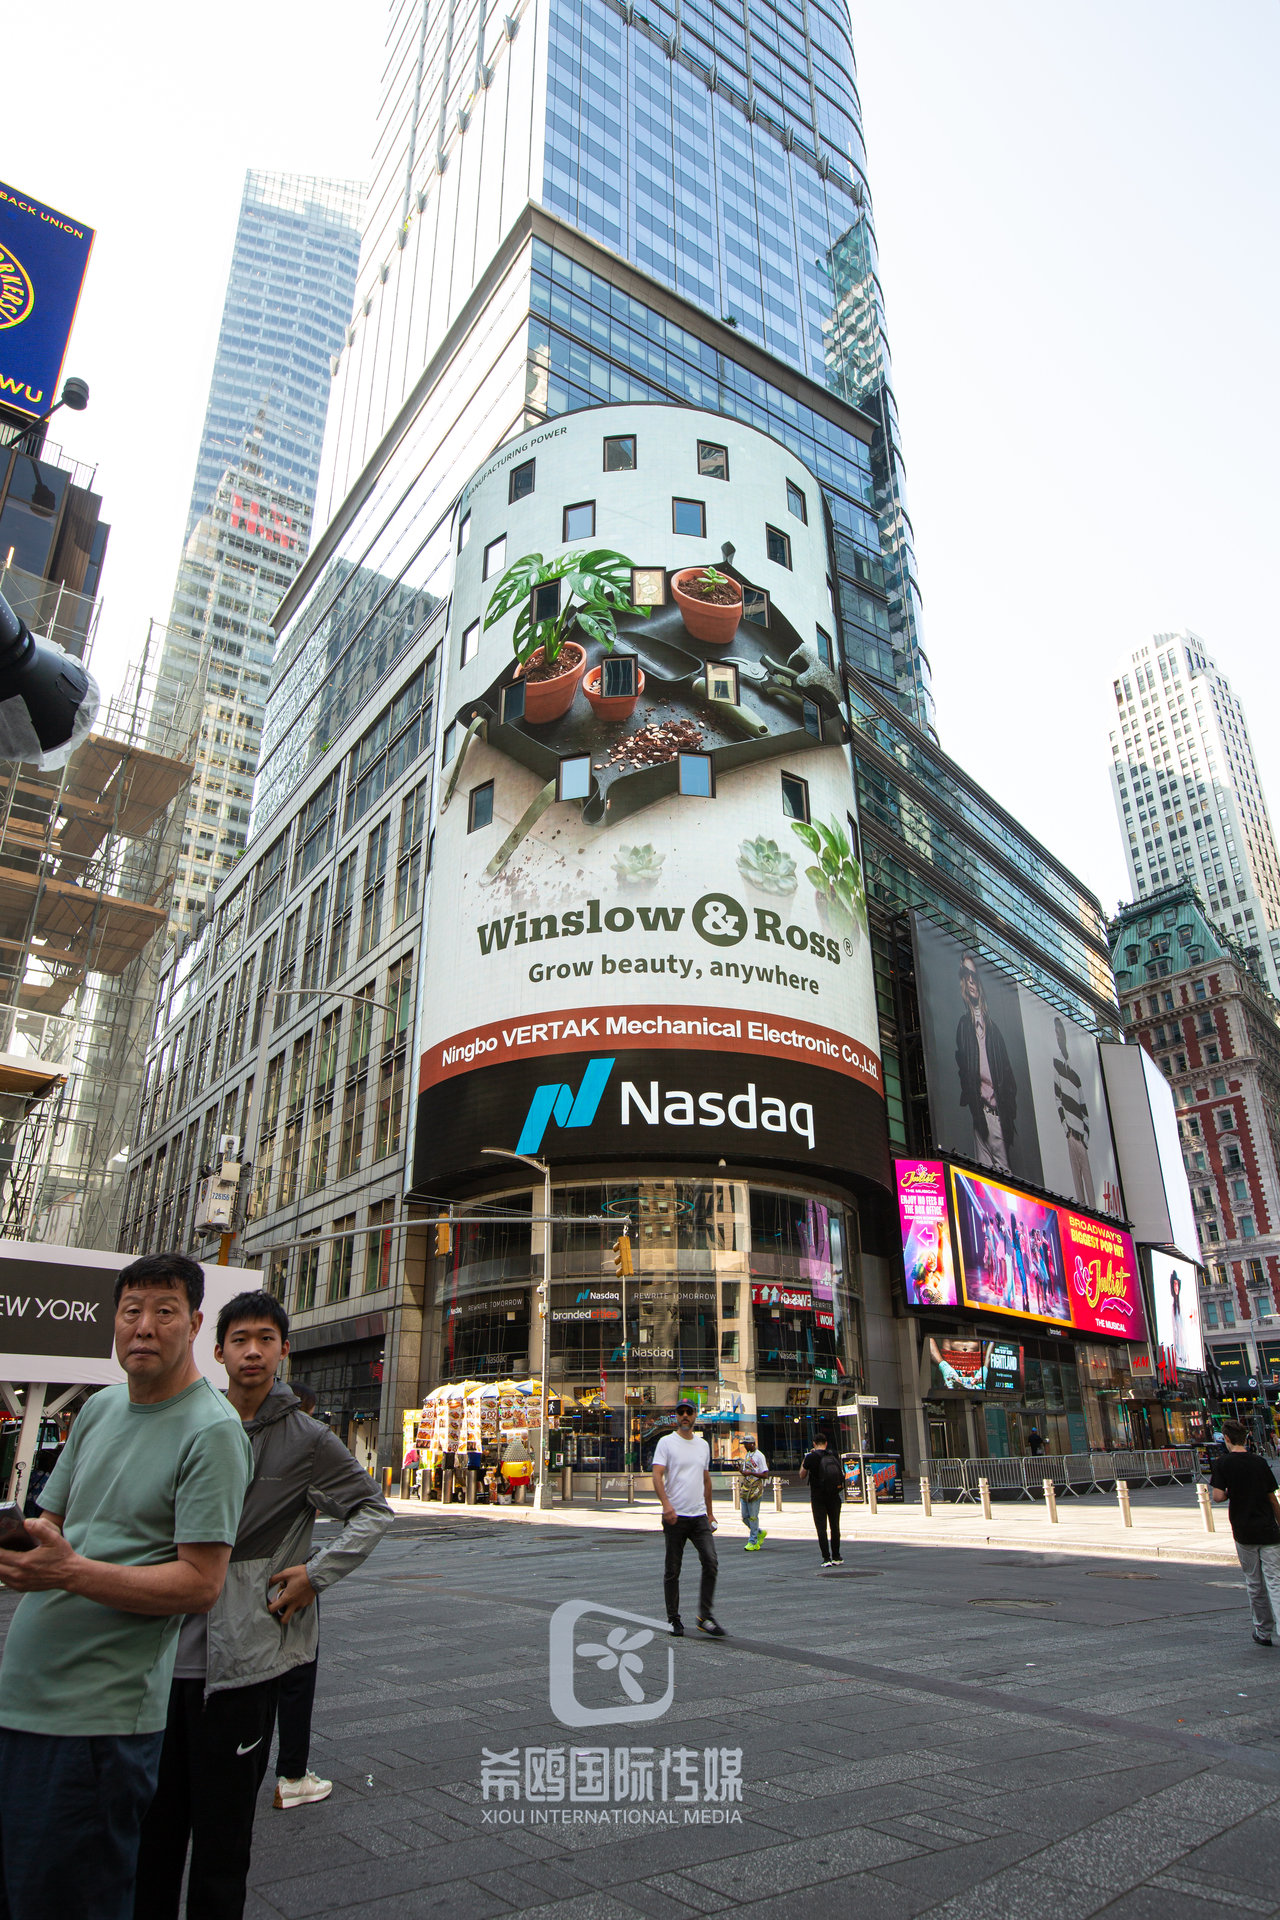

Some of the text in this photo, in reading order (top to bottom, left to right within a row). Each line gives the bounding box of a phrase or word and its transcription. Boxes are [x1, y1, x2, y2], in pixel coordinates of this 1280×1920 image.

[40, 211, 84, 240] UNION
[466, 426, 568, 501] MANUFACTURING POWER
[477, 899, 686, 956] Winslow
[701, 900, 740, 938] &
[528, 954, 819, 995] Grow beauty, anywhere
[441, 1036, 498, 1067] Ningbo
[502, 1017, 600, 1047] VERTAK
[606, 1015, 742, 1038] Mechanical
[747, 1020, 840, 1058] Electronic
[621, 1081, 815, 1150] Nasdaq
[901, 1170, 941, 1187] Juliet
[904, 1205, 914, 1214] THE
[1069, 1215, 1123, 1244] BROADWAY'S
[1070, 1228, 1124, 1258] BIGGEST POP HIT
[590, 1291, 620, 1301] Nasdaq
[633, 1292, 717, 1300] REWRITE TOMORROW
[1086, 1259, 1131, 1308] Juliet
[35, 1297, 100, 1322] YORK
[468, 1298, 523, 1312] REWRITE TOMORROW
[552, 1308, 618, 1320] brandedcities
[1095, 1318, 1127, 1332] THE MUSICAL
[631, 1347, 674, 1360] Nasdaq
